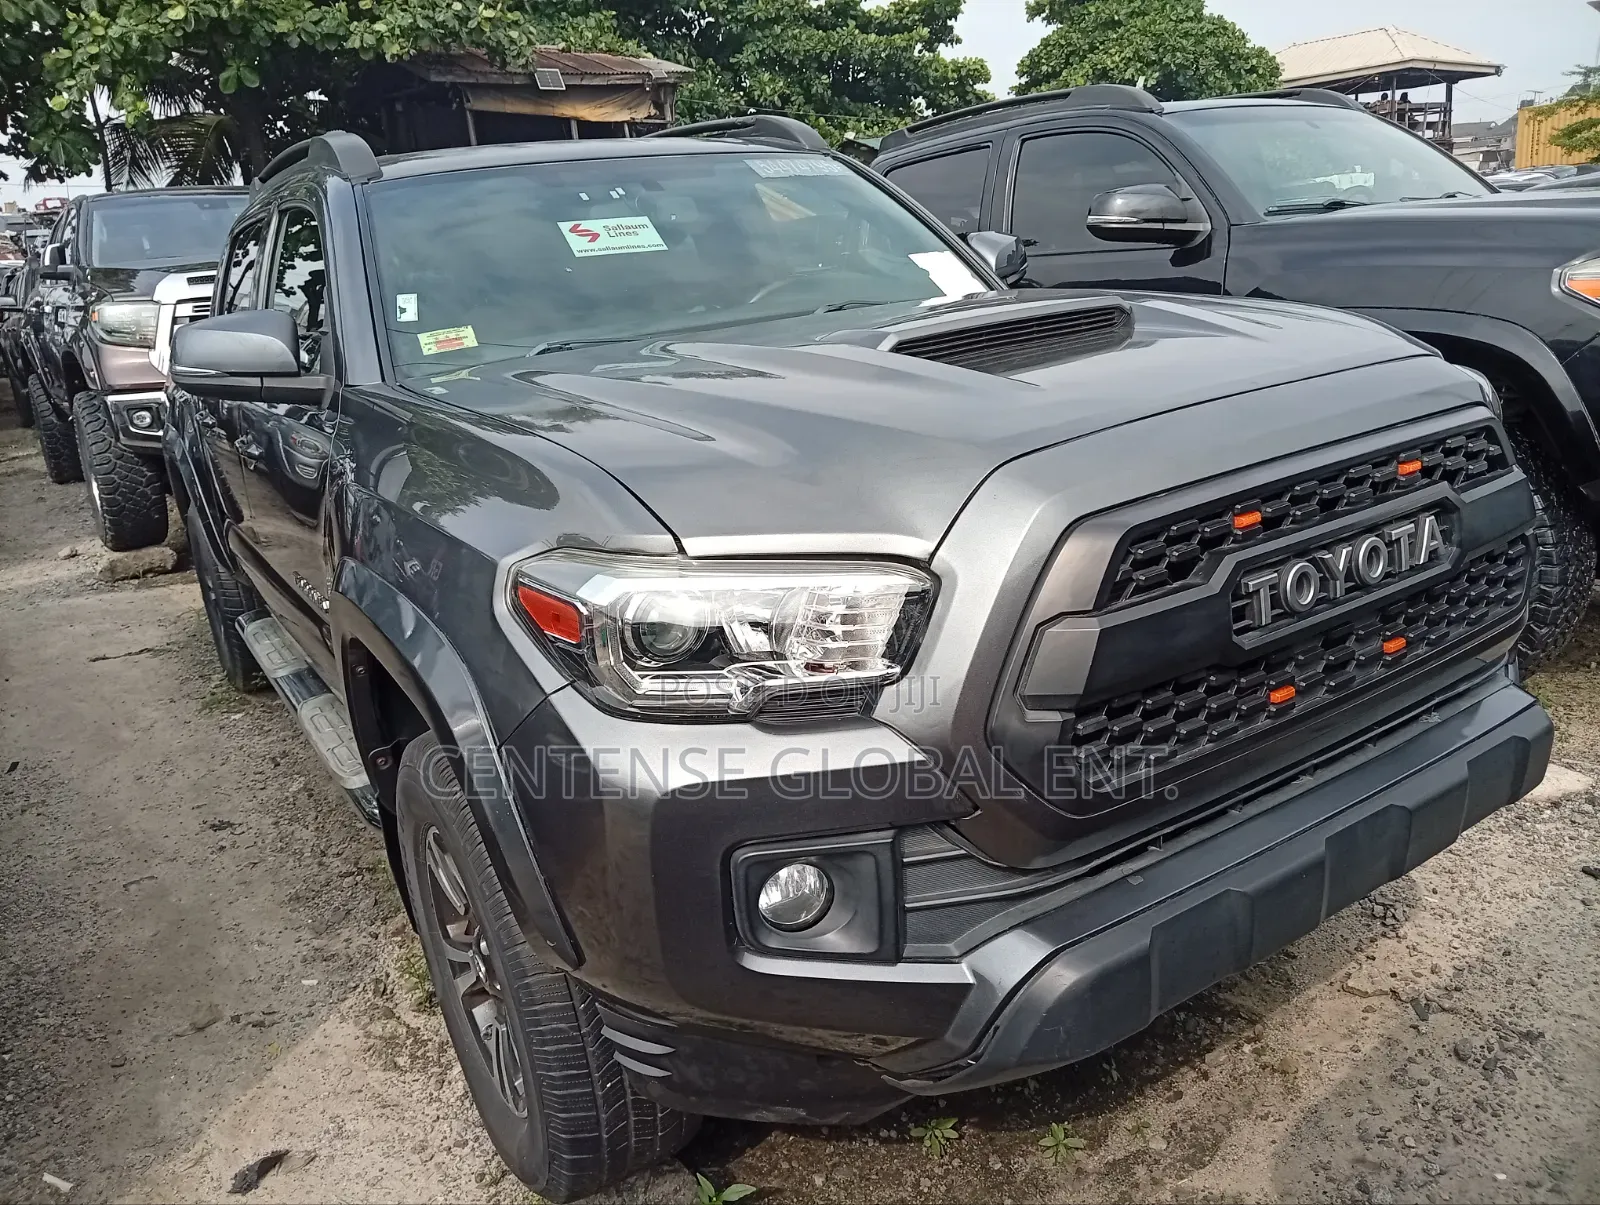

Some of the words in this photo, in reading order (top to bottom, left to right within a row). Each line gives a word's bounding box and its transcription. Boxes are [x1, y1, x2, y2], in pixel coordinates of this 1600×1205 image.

[603, 223, 649, 231] Sallaum
[607, 230, 639, 238] Lines
[576, 243, 664, 254] www.sallaumlines.com
[1241, 513, 1450, 627] TOYOTA
